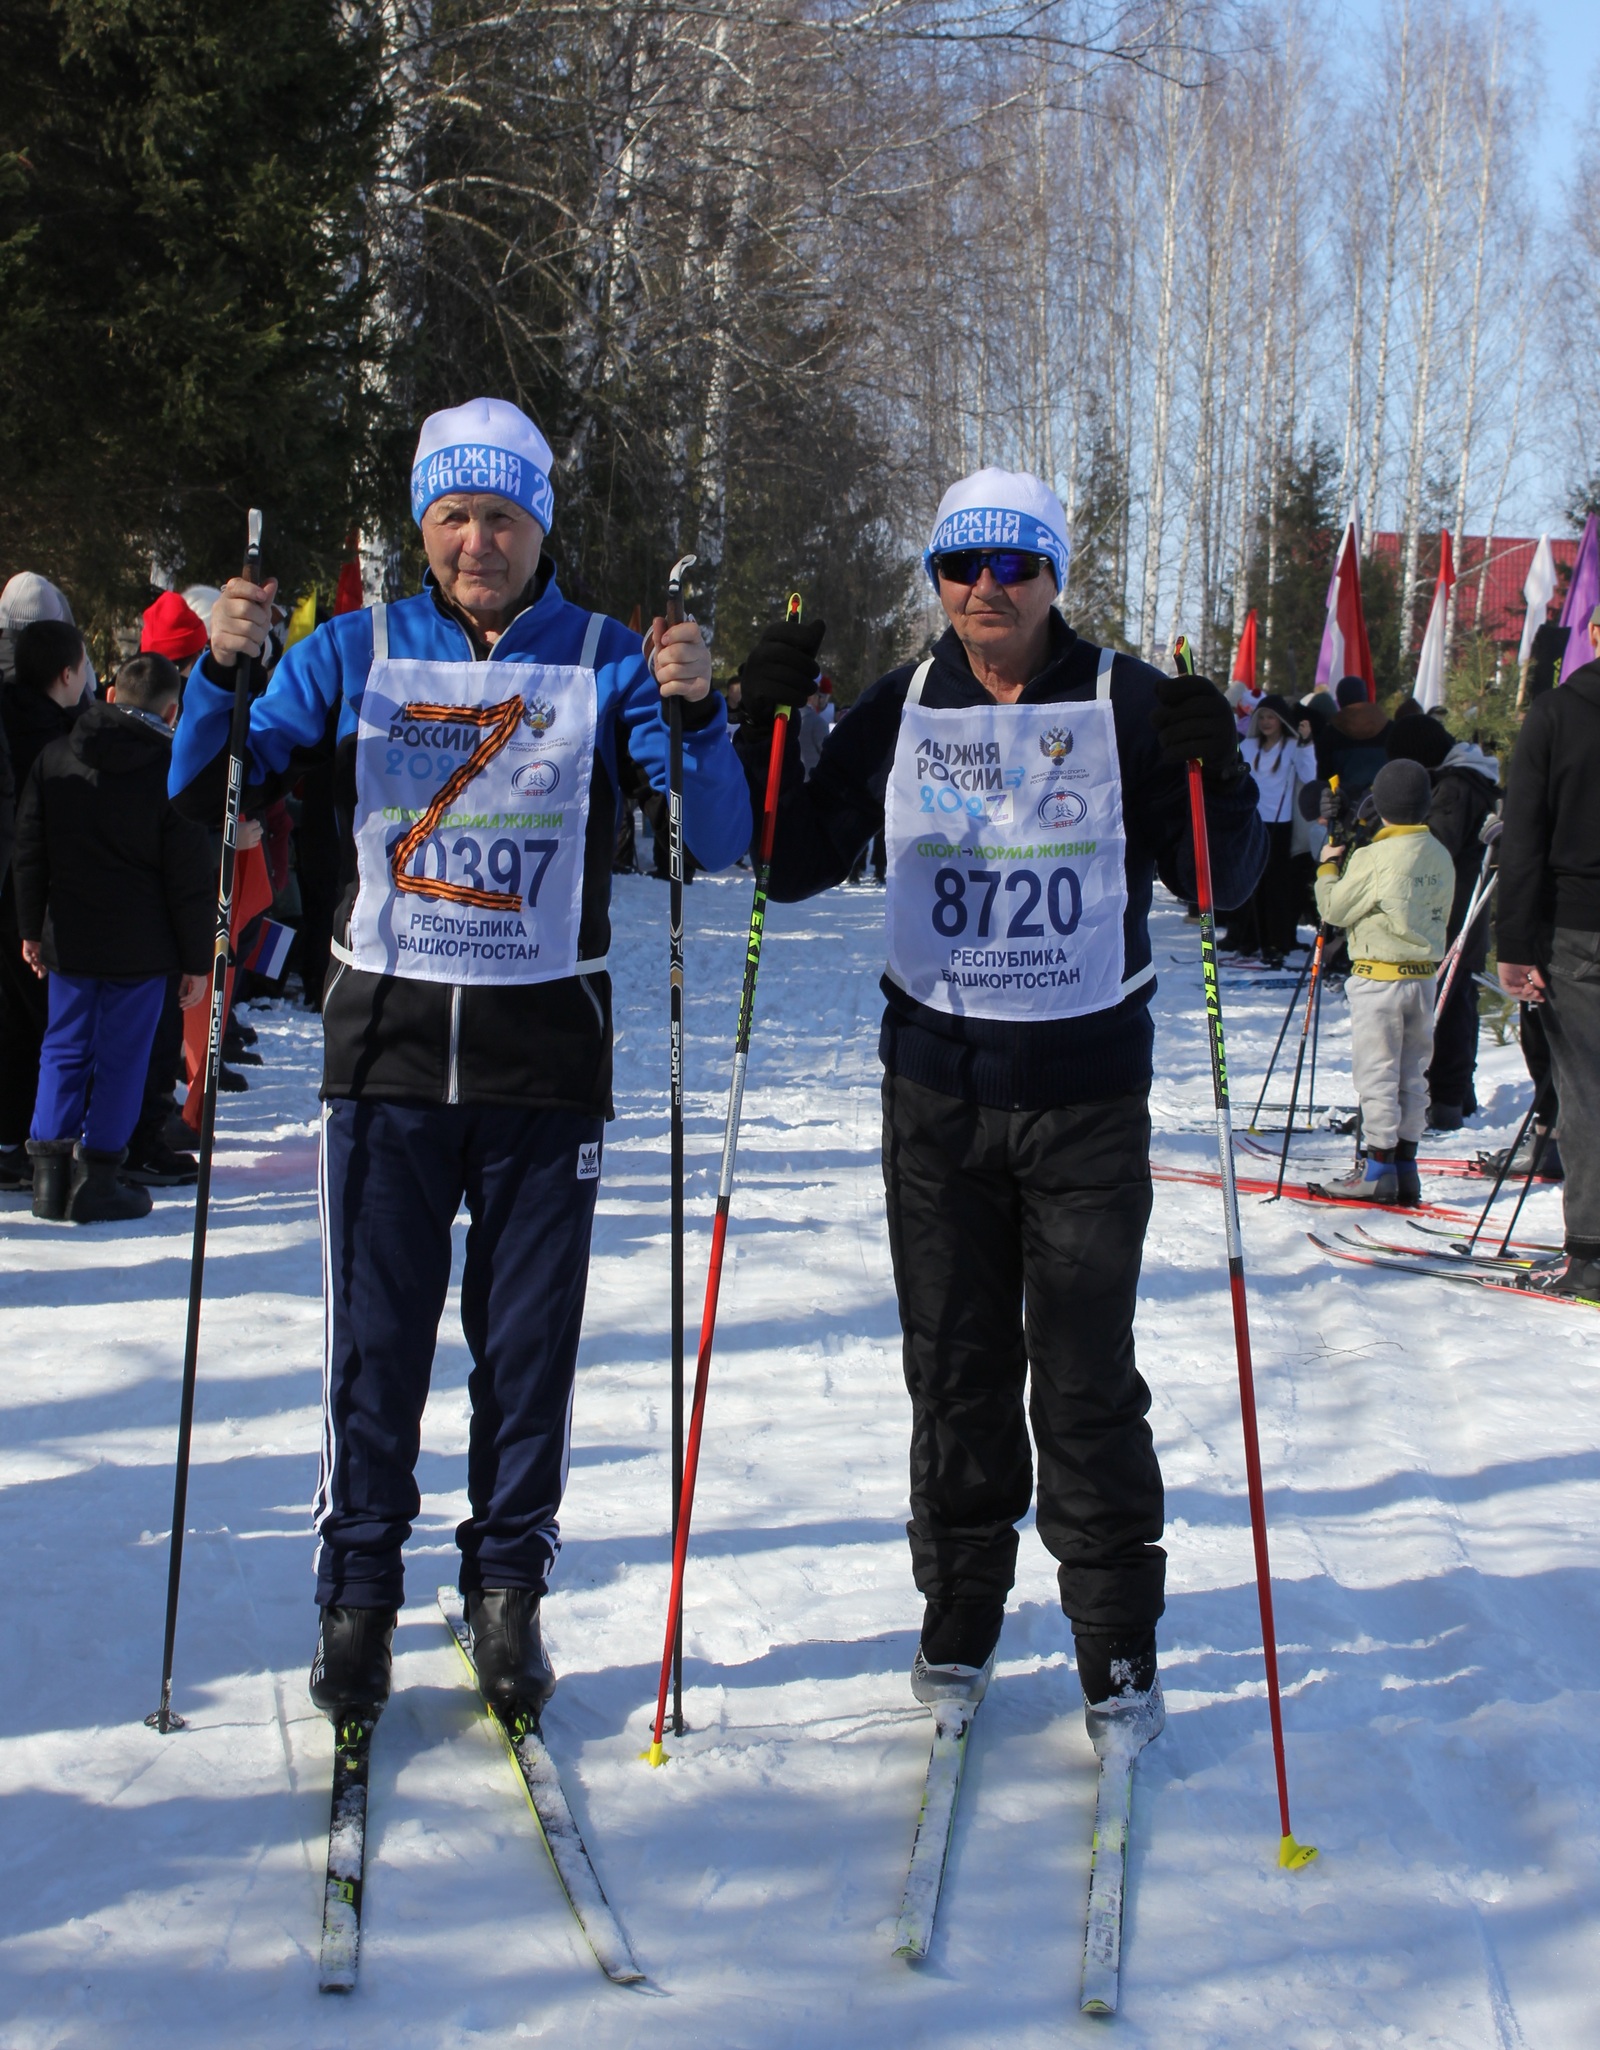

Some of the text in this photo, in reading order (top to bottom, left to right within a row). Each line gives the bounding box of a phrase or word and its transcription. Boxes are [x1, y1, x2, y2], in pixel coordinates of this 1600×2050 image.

[427, 448, 522, 478] ЛЫЖНЯ
[428, 467, 521, 496] РОССИИ
[387, 724, 481, 752] РОССИИ
[915, 738, 1000, 766] ЛЫЖНЯ
[385, 748, 489, 782] 202
[917, 757, 1003, 792] РОССИИ
[224, 754, 243, 849] STC
[503, 812, 564, 829] ЖИЗНИ
[670, 789, 683, 881] STC
[917, 841, 1097, 860] СПОРТ НОРМА ЖИЗНИ
[931, 867, 1082, 938] 8720
[410, 913, 528, 938] РЕСПУБЛИКА
[752, 889, 767, 964] LEKI
[397, 934, 540, 960] БАШКОРТОСТАН
[951, 948, 1067, 967] РЕСПУБЛИКА
[941, 967, 1080, 989] БАШКОРТОСТАН
[1200, 940, 1218, 1016] LEKI
[210, 989, 223, 1055] SPORT
[671, 1021, 681, 1085] SPORT
[579, 1165, 597, 1175] adidas
